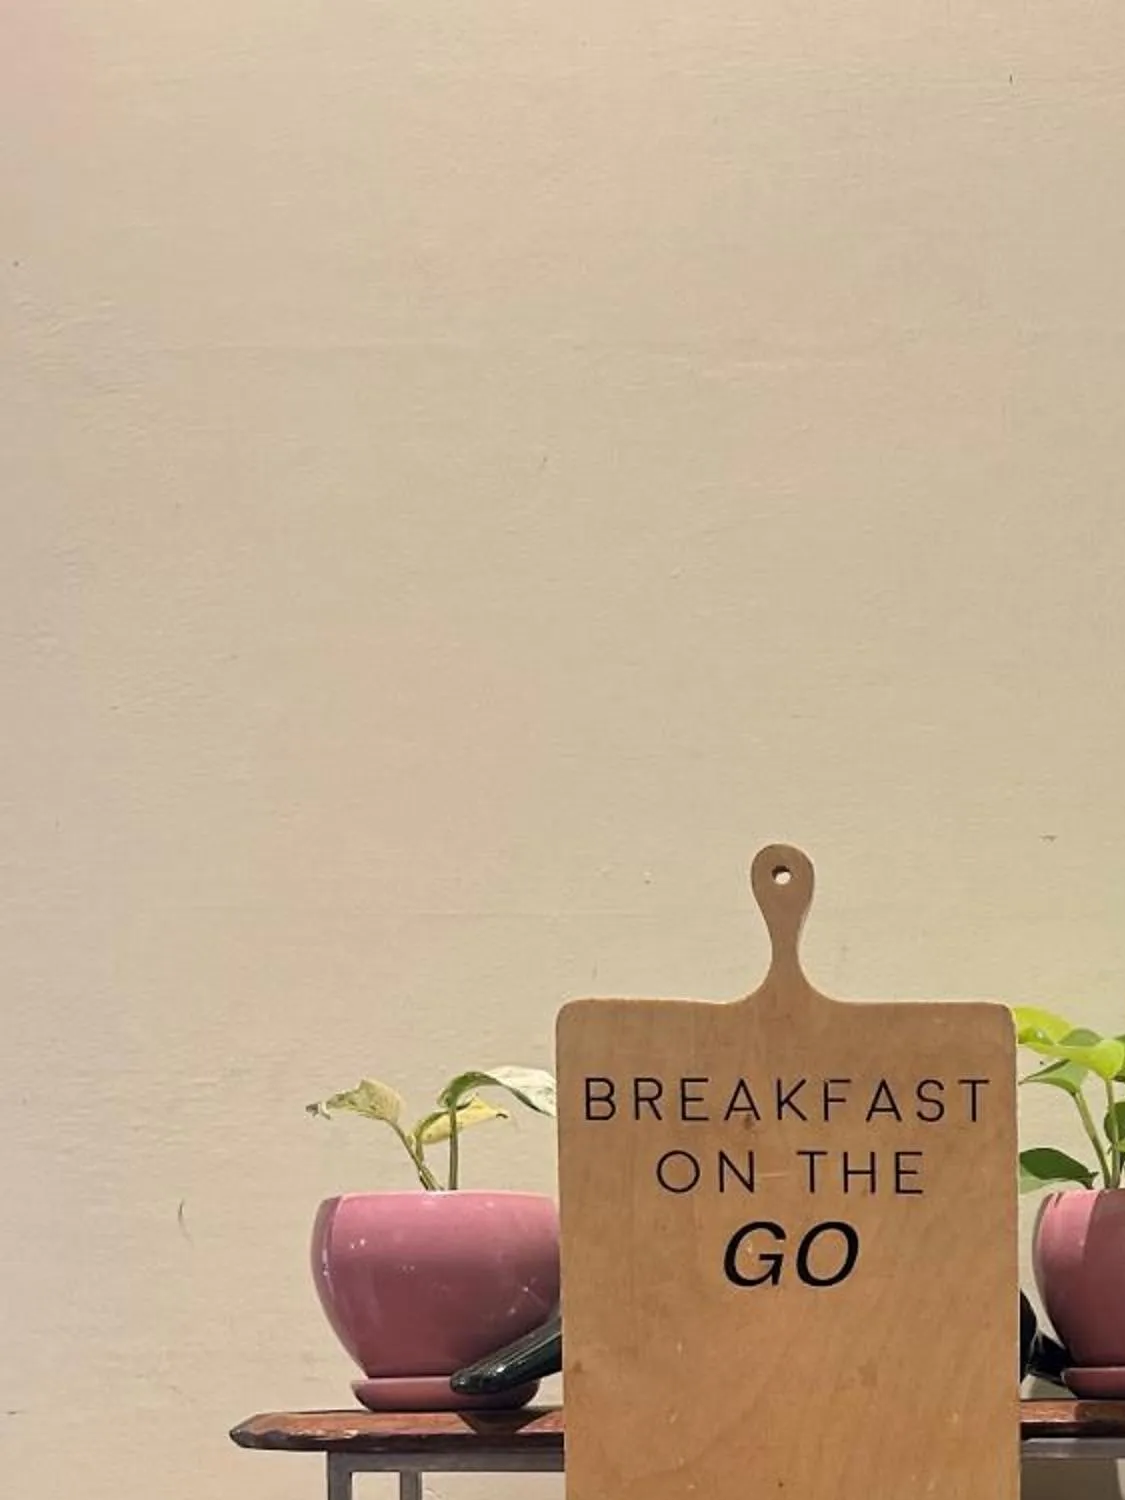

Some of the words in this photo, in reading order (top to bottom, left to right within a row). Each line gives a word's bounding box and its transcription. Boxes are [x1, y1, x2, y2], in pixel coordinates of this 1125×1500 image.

[584, 1076, 990, 1123] BREAKFAST
[656, 1149, 756, 1194] ON
[797, 1150, 924, 1195] THE
[722, 1220, 860, 1288] GO
